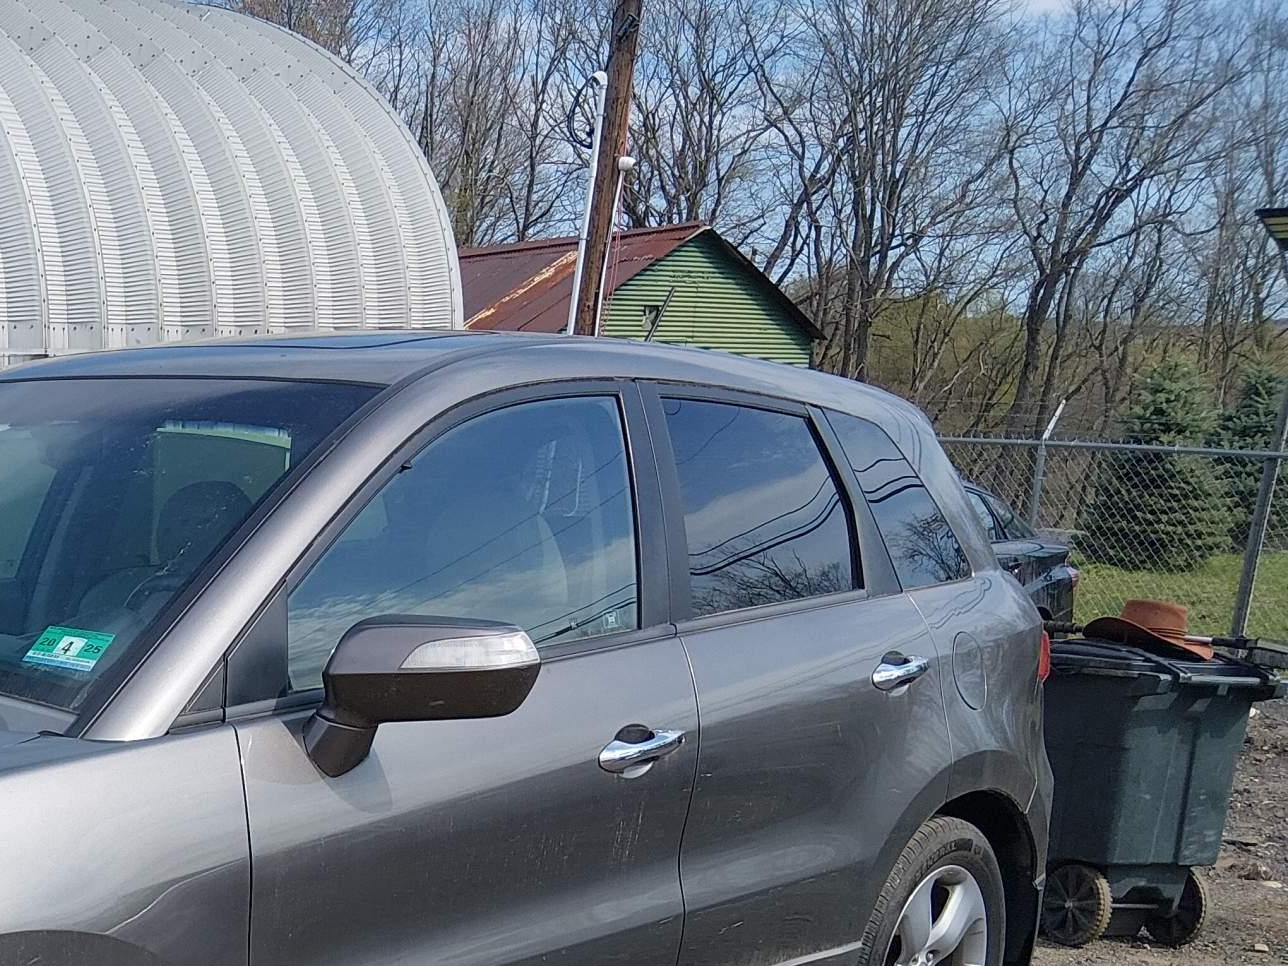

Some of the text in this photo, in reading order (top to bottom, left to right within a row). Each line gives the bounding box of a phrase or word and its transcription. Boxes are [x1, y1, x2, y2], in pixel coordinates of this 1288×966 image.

[40, 637, 102, 655] 20 4 25
